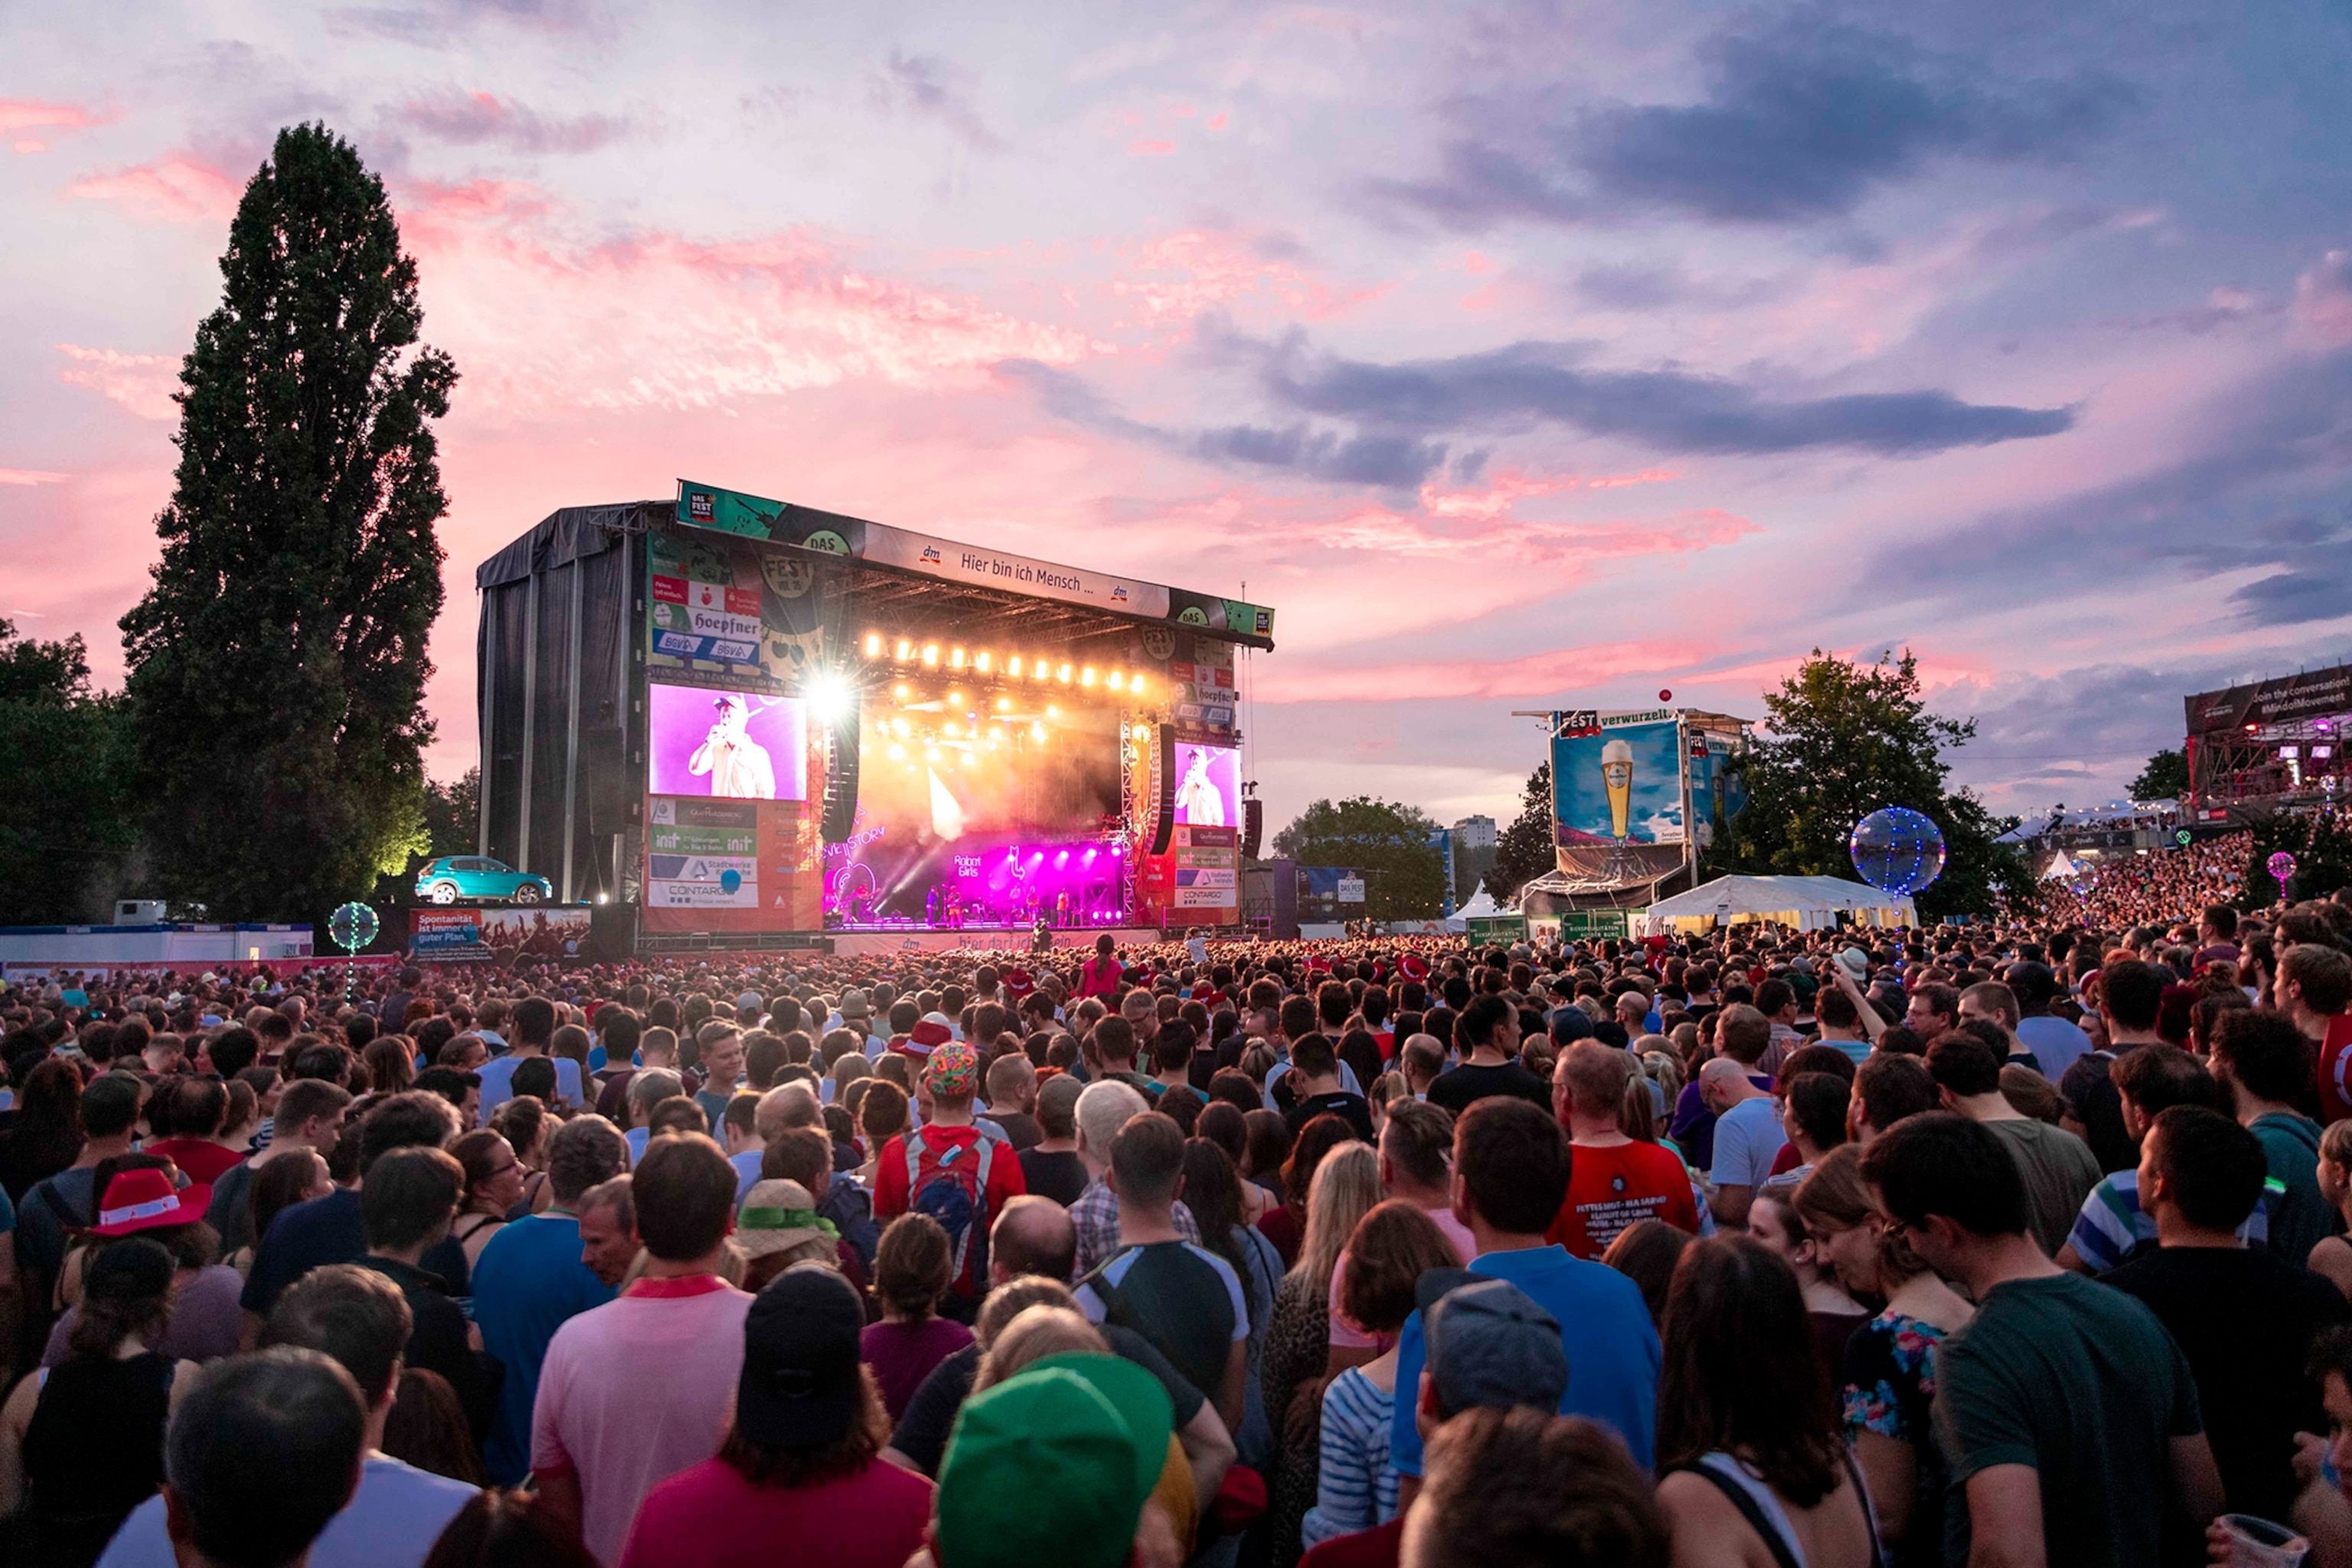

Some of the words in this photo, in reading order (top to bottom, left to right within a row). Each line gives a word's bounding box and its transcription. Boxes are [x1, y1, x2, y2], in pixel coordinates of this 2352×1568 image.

[691, 501, 711, 511] FEST
[810, 537, 835, 550] DAS
[923, 545, 941, 559] dm
[765, 559, 809, 578] FEST
[962, 553, 989, 573] Hier
[992, 559, 1011, 578] bin
[1014, 564, 1032, 582] ich
[1036, 569, 1080, 592] Mensch
[1113, 585, 1127, 597] dm
[1183, 612, 1199, 623] DAS
[2253, 691, 2272, 704] Join
[2273, 689, 2288, 700] the
[2288, 676, 2350, 697] conversation!
[1563, 714, 1596, 729] FEST
[1602, 709, 1673, 727] verwurzelt.
[1690, 736, 1706, 747] FEST
[656, 832, 681, 849] init
[727, 835, 753, 851] init
[419, 915, 472, 924] Spontanität
[419, 924, 430, 933] ist
[432, 924, 462, 933] immer
[419, 935, 443, 944] guter
[445, 933, 467, 942] Plan.
[903, 937, 920, 949] dm
[988, 935, 1014, 950] darf
[1017, 935, 1034, 949] ich
